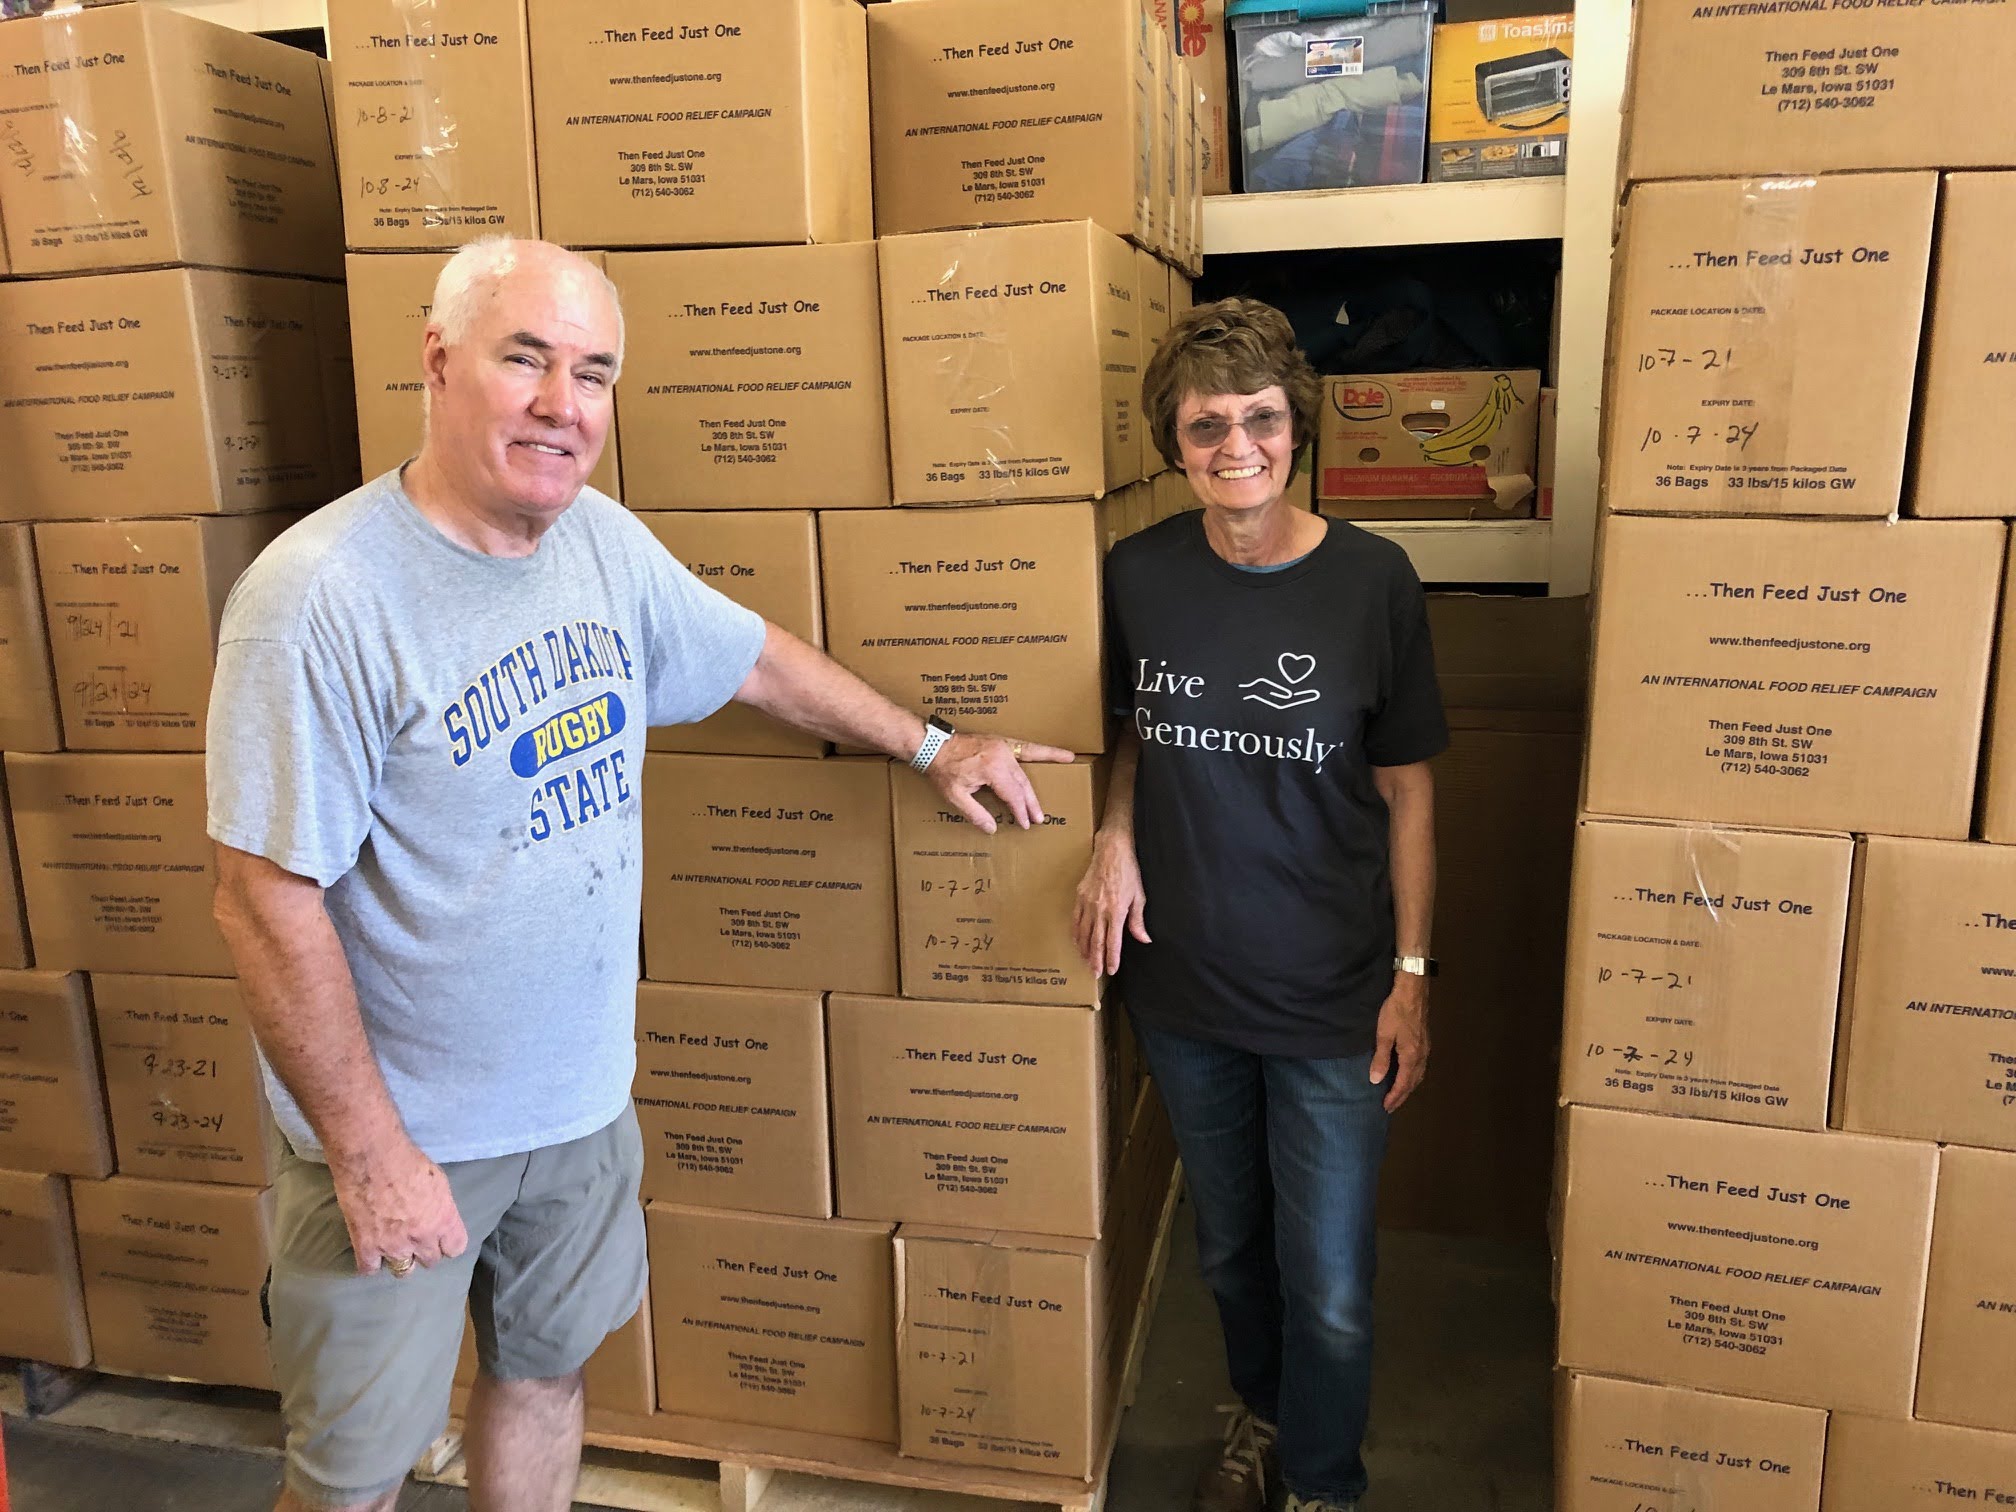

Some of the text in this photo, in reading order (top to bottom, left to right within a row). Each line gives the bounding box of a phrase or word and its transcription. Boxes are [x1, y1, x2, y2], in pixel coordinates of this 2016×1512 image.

[405, 34, 435, 47] Feed
[441, 34, 468, 46] Just
[474, 33, 498, 45] One
[642, 26, 673, 41] Feed
[679, 26, 709, 39] Just
[715, 24, 741, 37] One
[979, 43, 1009, 57] Feed
[1015, 41, 1043, 54] Just
[1049, 38, 1074, 50] One
[1765, 46, 1899, 62] Then Feed Just One
[103, 53, 125, 65] One
[610, 73, 721, 85] www.thenfeedjustone.org
[632, 187, 694, 198] (712) 540-3062
[1746, 248, 1792, 267] Feed
[1800, 249, 1843, 265] Just
[1852, 247, 1889, 263] One
[965, 285, 998, 299] Feed
[1004, 283, 1033, 297] Just
[1040, 282, 1066, 294] One
[721, 302, 753, 315] Feed
[758, 302, 788, 314] Just
[794, 300, 820, 313] One
[689, 346, 801, 357] www.thenfeedjustone.org
[647, 381, 851, 394] AN INTERNATIONAL FOOD RELIEF CAMPAIGN
[1343, 388, 1385, 409] Dole
[926, 473, 938, 482] 36
[940, 472, 965, 483] Bags
[979, 470, 991, 479] 33
[1025, 468, 1049, 477] kilos
[1052, 466, 1070, 475] GW
[1656, 476, 1856, 490] 36 Bags 33 lbs/15 kilos GW
[159, 563, 180, 574] One
[937, 560, 968, 573] Feed
[975, 559, 1004, 572] Just
[1010, 558, 1036, 570] One
[1763, 584, 1809, 600] Feed
[1817, 586, 1861, 602] Just
[1869, 588, 1906, 603] One
[905, 602, 1017, 612] www.thenfeedjustone.org
[1710, 637, 1870, 653] www.thenfeedjustone.org
[1136, 658, 1205, 699] Live
[1641, 675, 1937, 698] AN INTERNATIONAL FOOD RELIEF CAMPAIGN
[441, 639, 549, 768] SOUTH
[532, 696, 613, 769] RUGBY
[1709, 720, 1832, 736] Then Feed Just One
[1723, 735, 1813, 749] 309 8th St. SW
[1706, 747, 1827, 764] Le Mars, Iowa 51031
[1721, 762, 1809, 777] (712) 540-3062
[529, 748, 631, 843] STATE
[742, 807, 771, 819] Feed
[776, 809, 804, 820] Just
[810, 810, 833, 821] One
[1683, 891, 1724, 908] Feed
[1732, 896, 1771, 911] Just
[1778, 900, 1813, 915] One
[680, 1034, 708, 1046] Feed
[713, 1036, 740, 1048] Just
[745, 1039, 768, 1050] One
[942, 1050, 972, 1062] Feed
[978, 1052, 1006, 1064] Just
[1012, 1054, 1037, 1065] One
[1605, 1078, 1789, 1107] 36 Bags 33 lbs/15 kilos GW
[1717, 1181, 1759, 1198] Feed
[1767, 1188, 1807, 1204] Just
[1815, 1194, 1850, 1209] One
[1667, 1222, 1818, 1251] www.thenfeedjustone.org
[749, 1262, 777, 1276] Feed
[783, 1266, 809, 1279] Just
[814, 1270, 837, 1282] One
[1605, 1250, 1881, 1295] AN INTERNATIONAL FOOD RELIEF CAMPAIGN
[972, 1291, 1001, 1305] Feed
[1006, 1296, 1033, 1308] Just
[1038, 1299, 1063, 1312] One
[1670, 1446, 1709, 1463] Feed
[1716, 1453, 1752, 1468] Just
[1759, 1460, 1791, 1474] One
